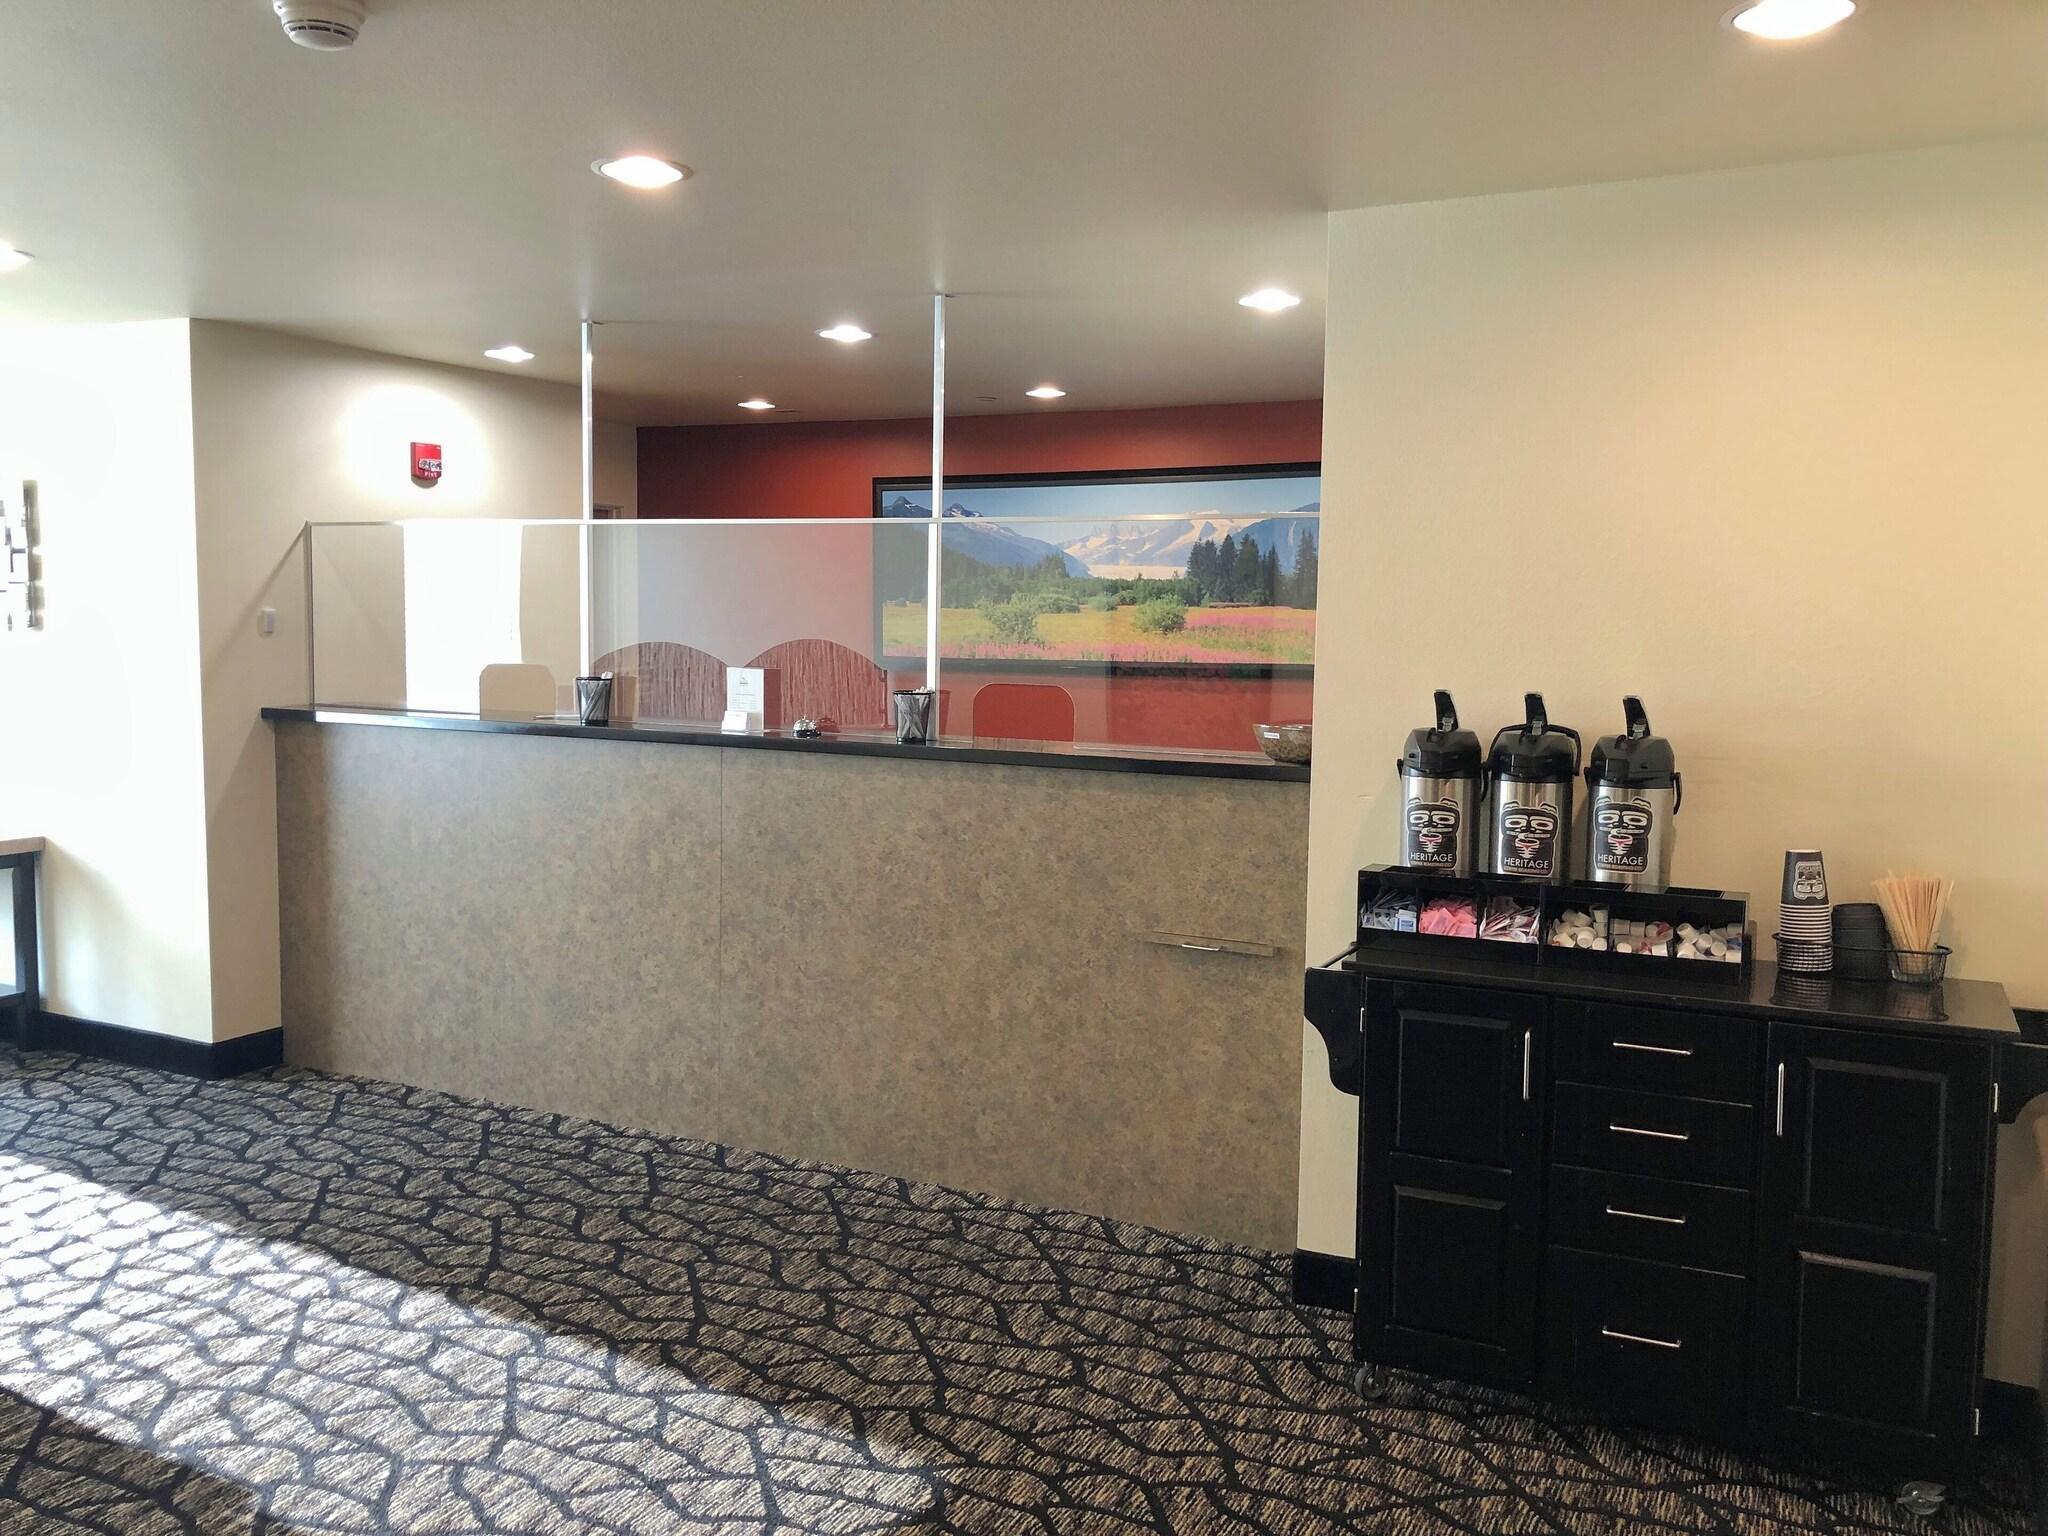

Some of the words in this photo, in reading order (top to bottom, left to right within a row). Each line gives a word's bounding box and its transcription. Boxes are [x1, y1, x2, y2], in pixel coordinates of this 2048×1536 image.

[1410, 851, 1453, 862] HERITAGE
[1597, 853, 1644, 865] HERITAGE
[1504, 857, 1549, 869] HERITAGE
